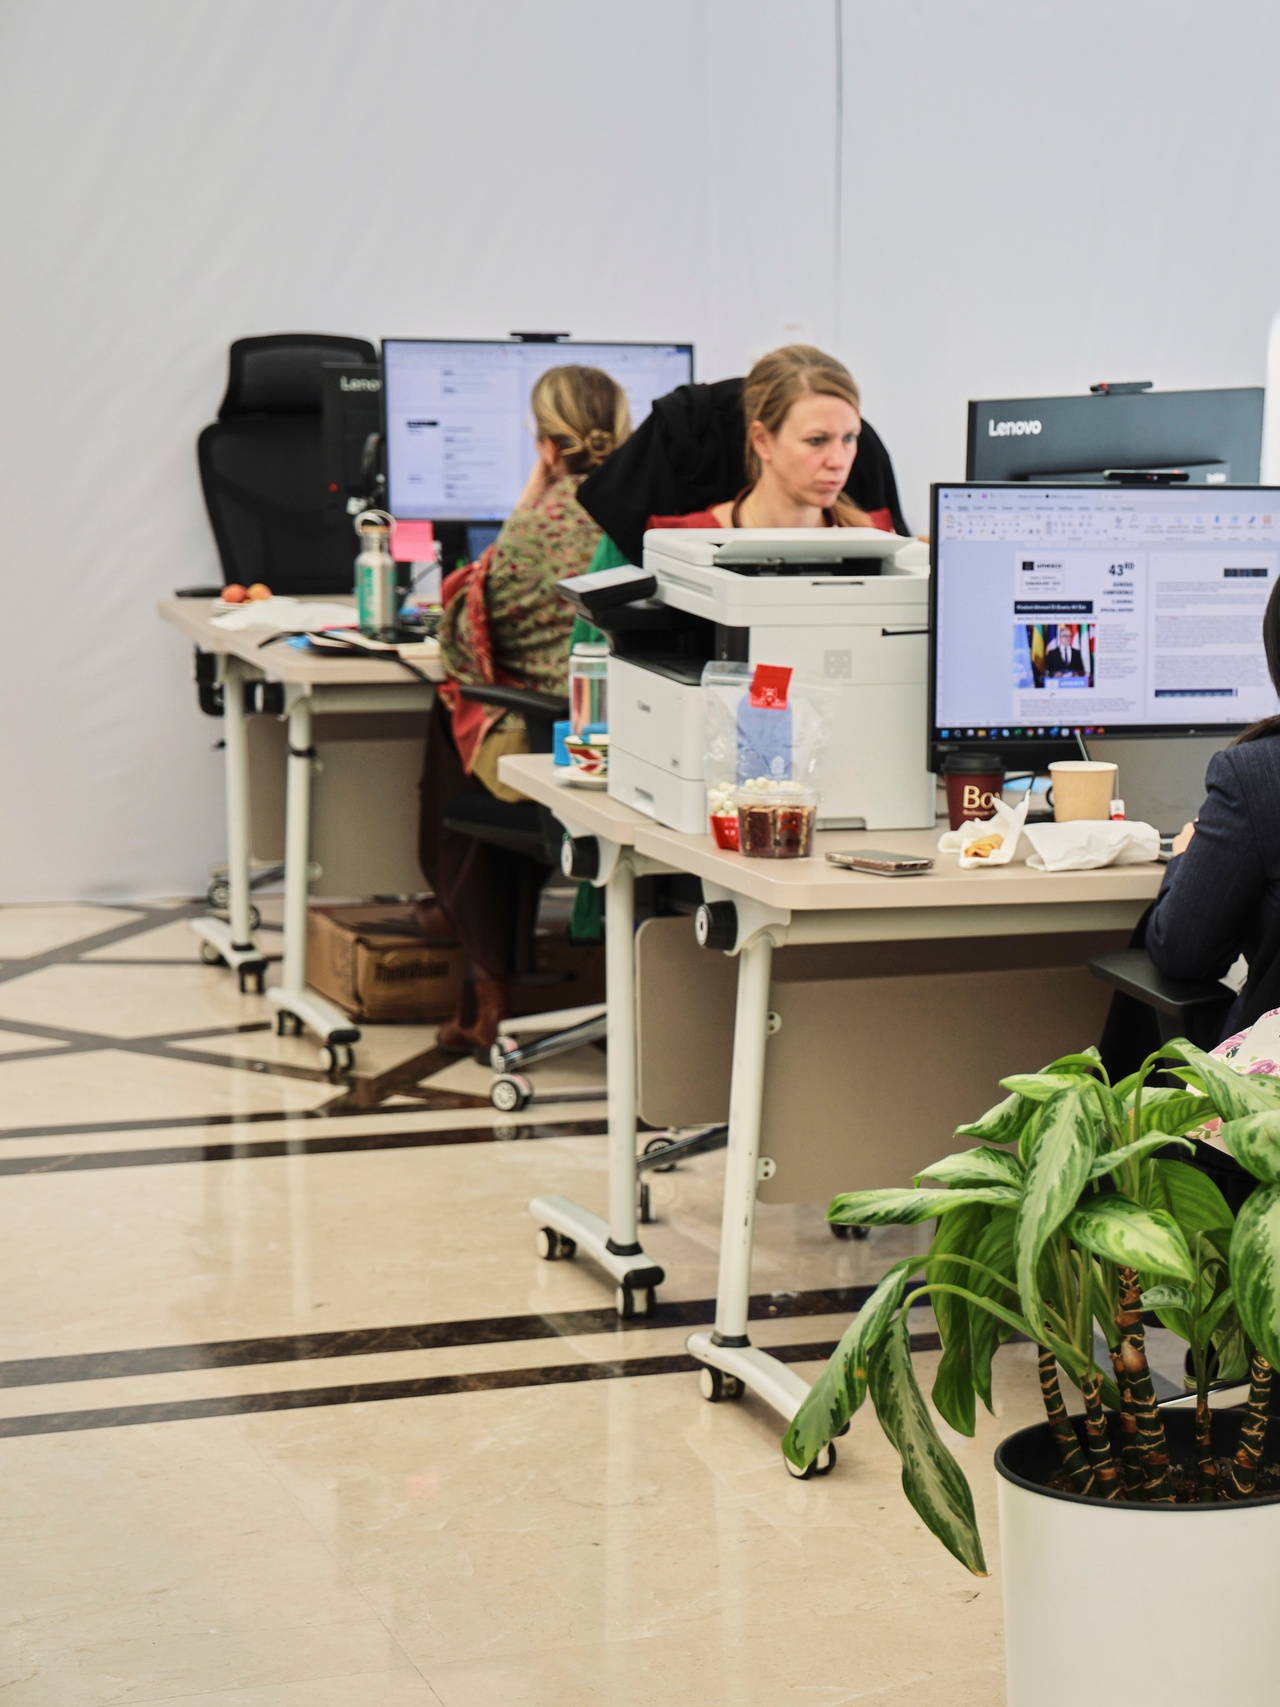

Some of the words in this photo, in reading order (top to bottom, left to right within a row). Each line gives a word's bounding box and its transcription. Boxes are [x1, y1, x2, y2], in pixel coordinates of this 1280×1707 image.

[340, 375, 383, 392] Leno
[988, 419, 1042, 437] Lenovo
[963, 785, 1000, 809] Bo
